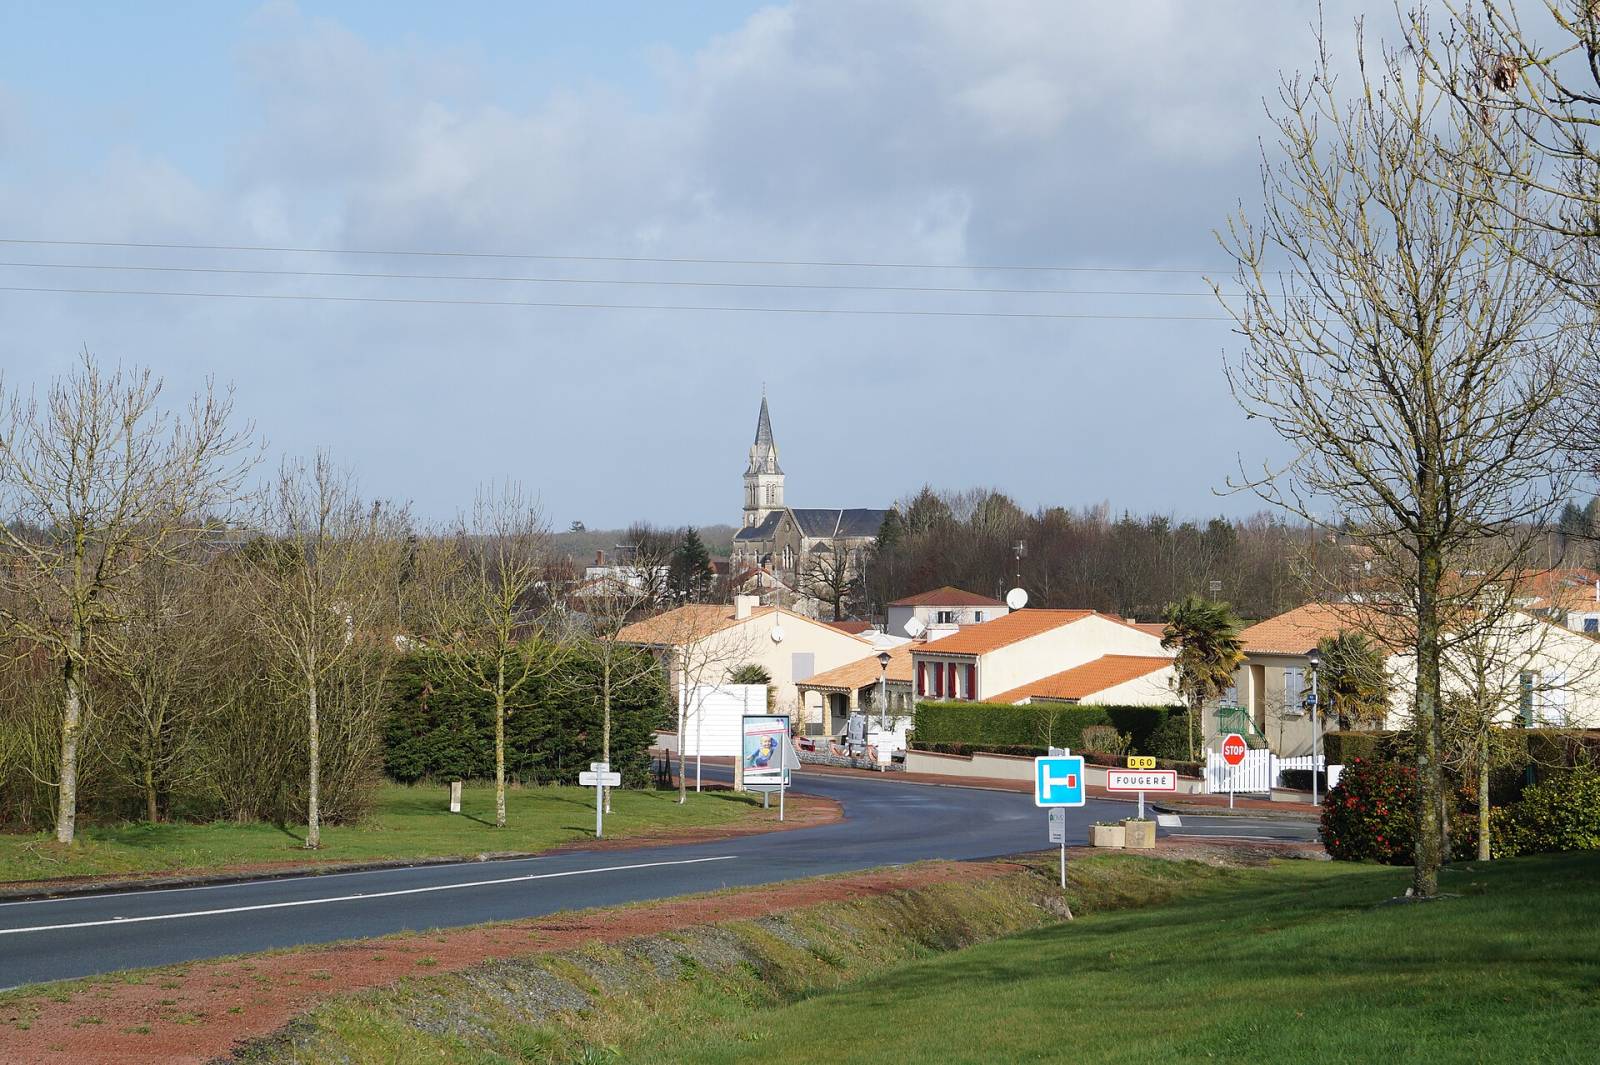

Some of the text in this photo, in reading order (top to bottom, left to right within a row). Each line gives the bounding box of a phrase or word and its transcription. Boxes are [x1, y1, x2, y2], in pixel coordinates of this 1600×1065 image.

[1225, 745, 1244, 755] STOP
[1130, 758, 1153, 766] D 60
[1116, 775, 1167, 785] FOUGERÉ
